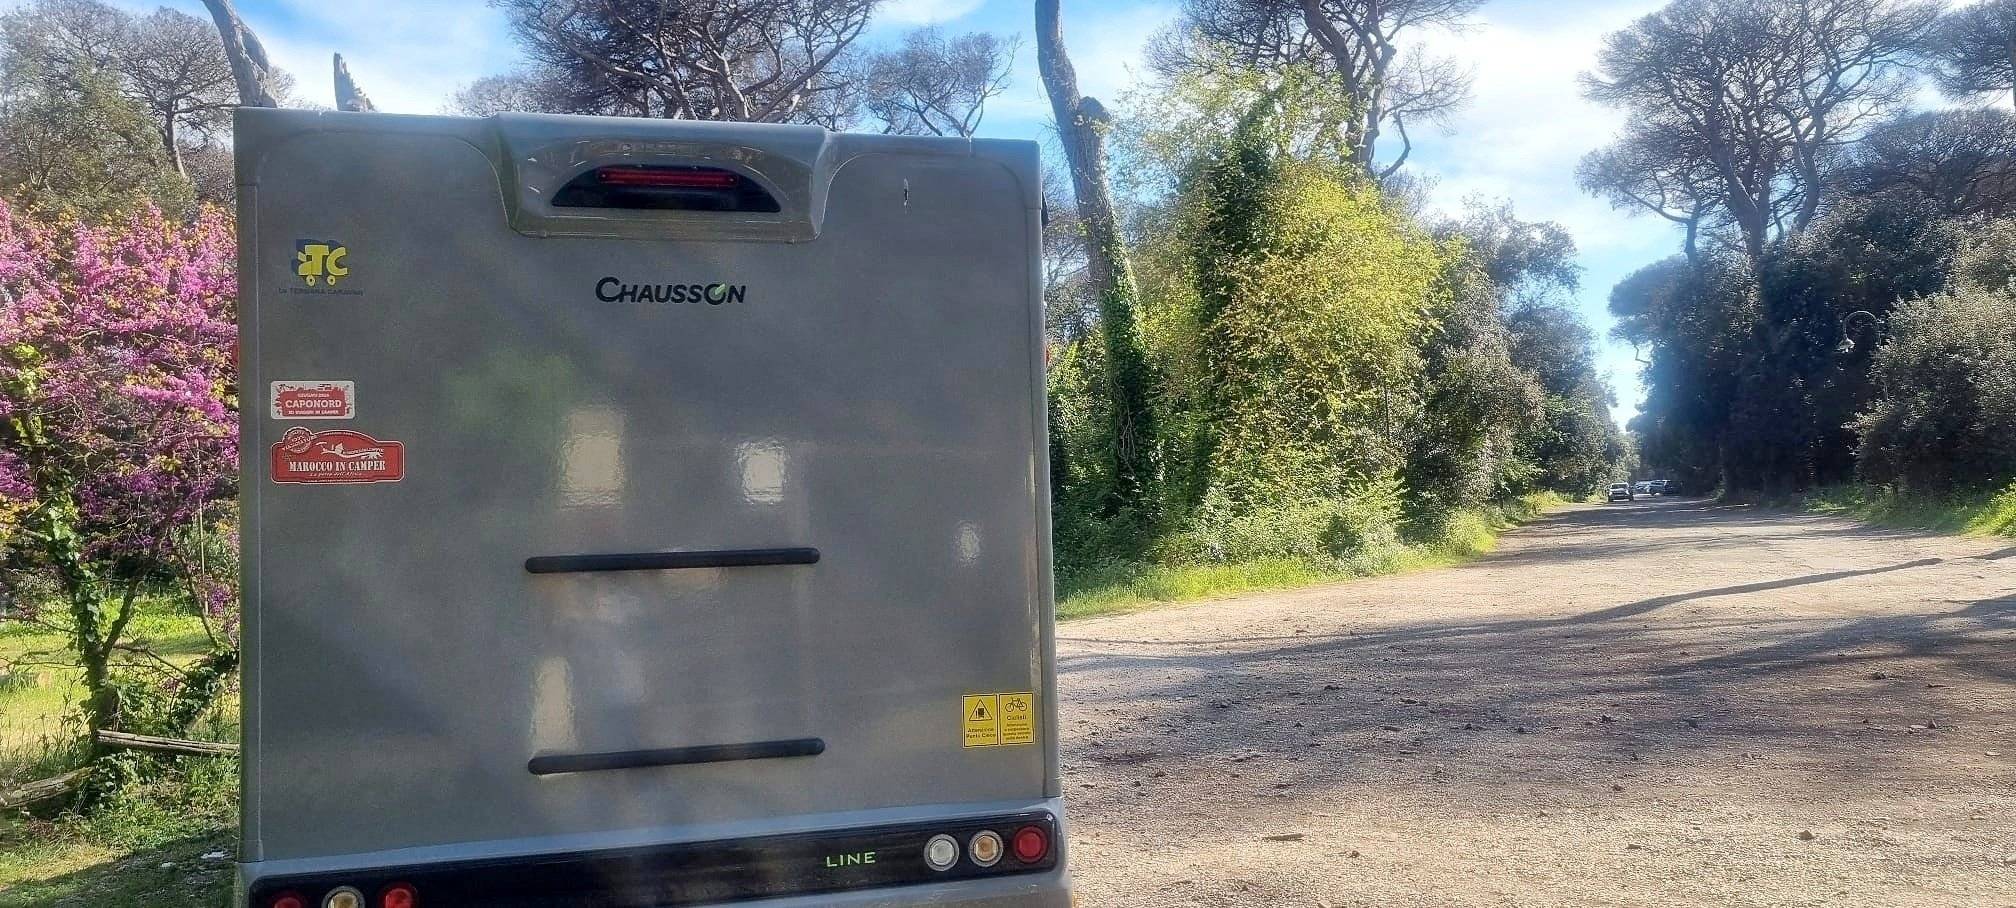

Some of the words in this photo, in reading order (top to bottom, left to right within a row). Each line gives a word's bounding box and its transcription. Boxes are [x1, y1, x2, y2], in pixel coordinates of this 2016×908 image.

[595, 276, 746, 305] CHAUSSON
[285, 399, 342, 408] CAPONORD
[288, 461, 333, 472] MAROCCO
[335, 461, 347, 471] IN
[348, 460, 386, 471] CAMPER
[826, 851, 876, 867] LINE
